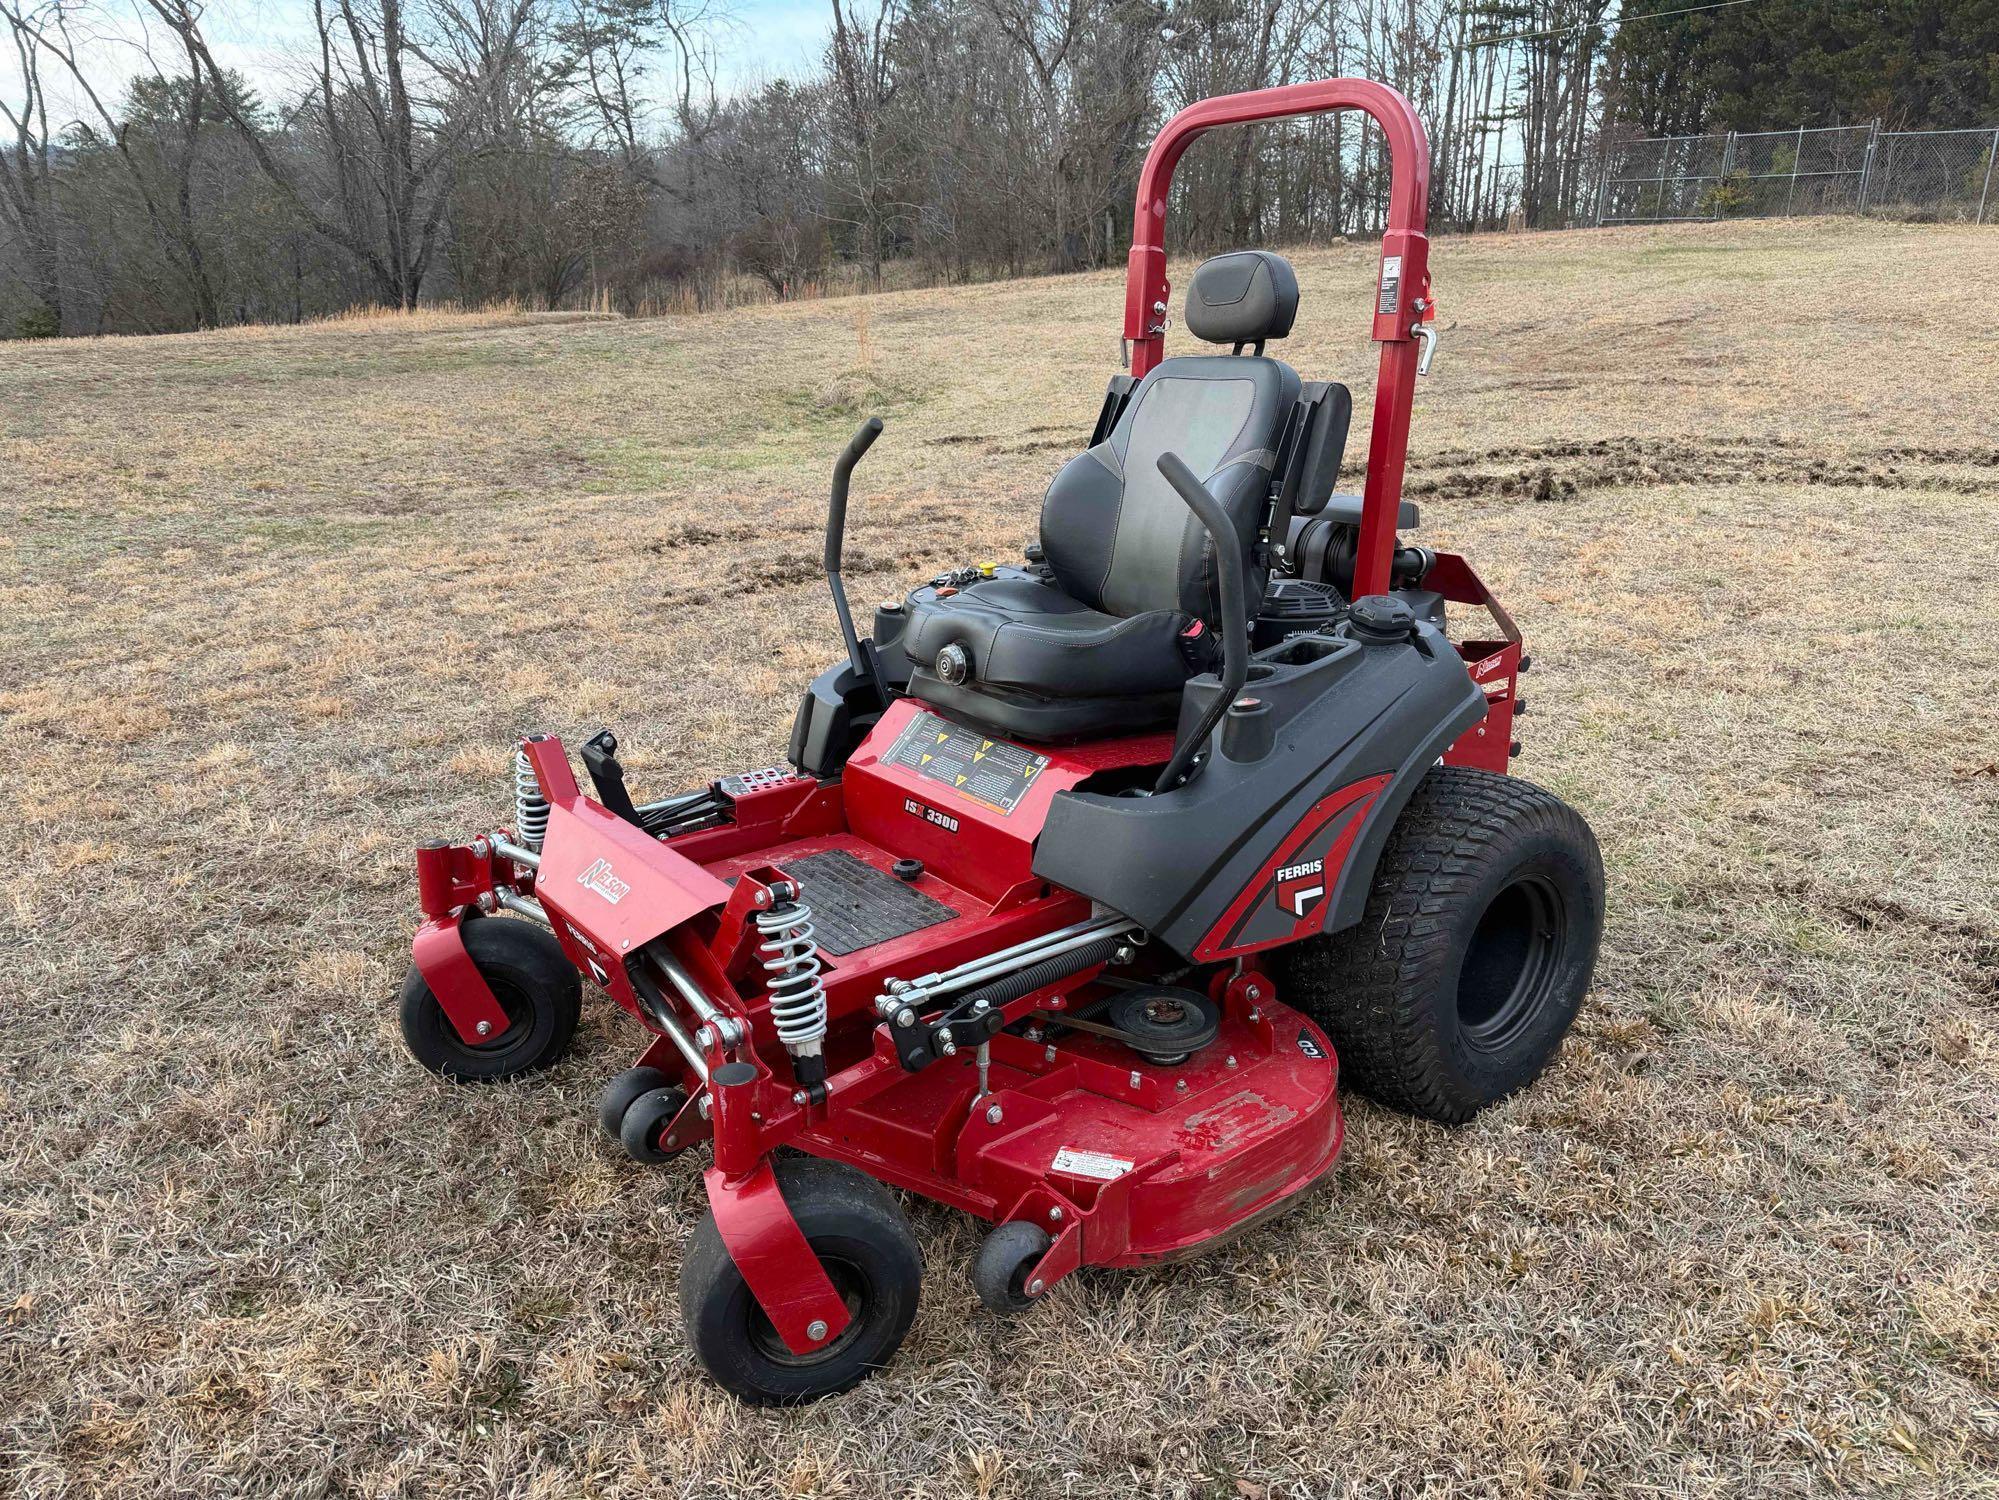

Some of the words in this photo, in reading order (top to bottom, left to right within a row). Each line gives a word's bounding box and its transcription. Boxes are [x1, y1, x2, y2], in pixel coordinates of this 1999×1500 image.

[905, 799, 924, 816] ISX
[927, 808, 959, 833] 3300
[578, 859, 629, 897] NELSON
[1277, 860, 1322, 882] FERRIS
